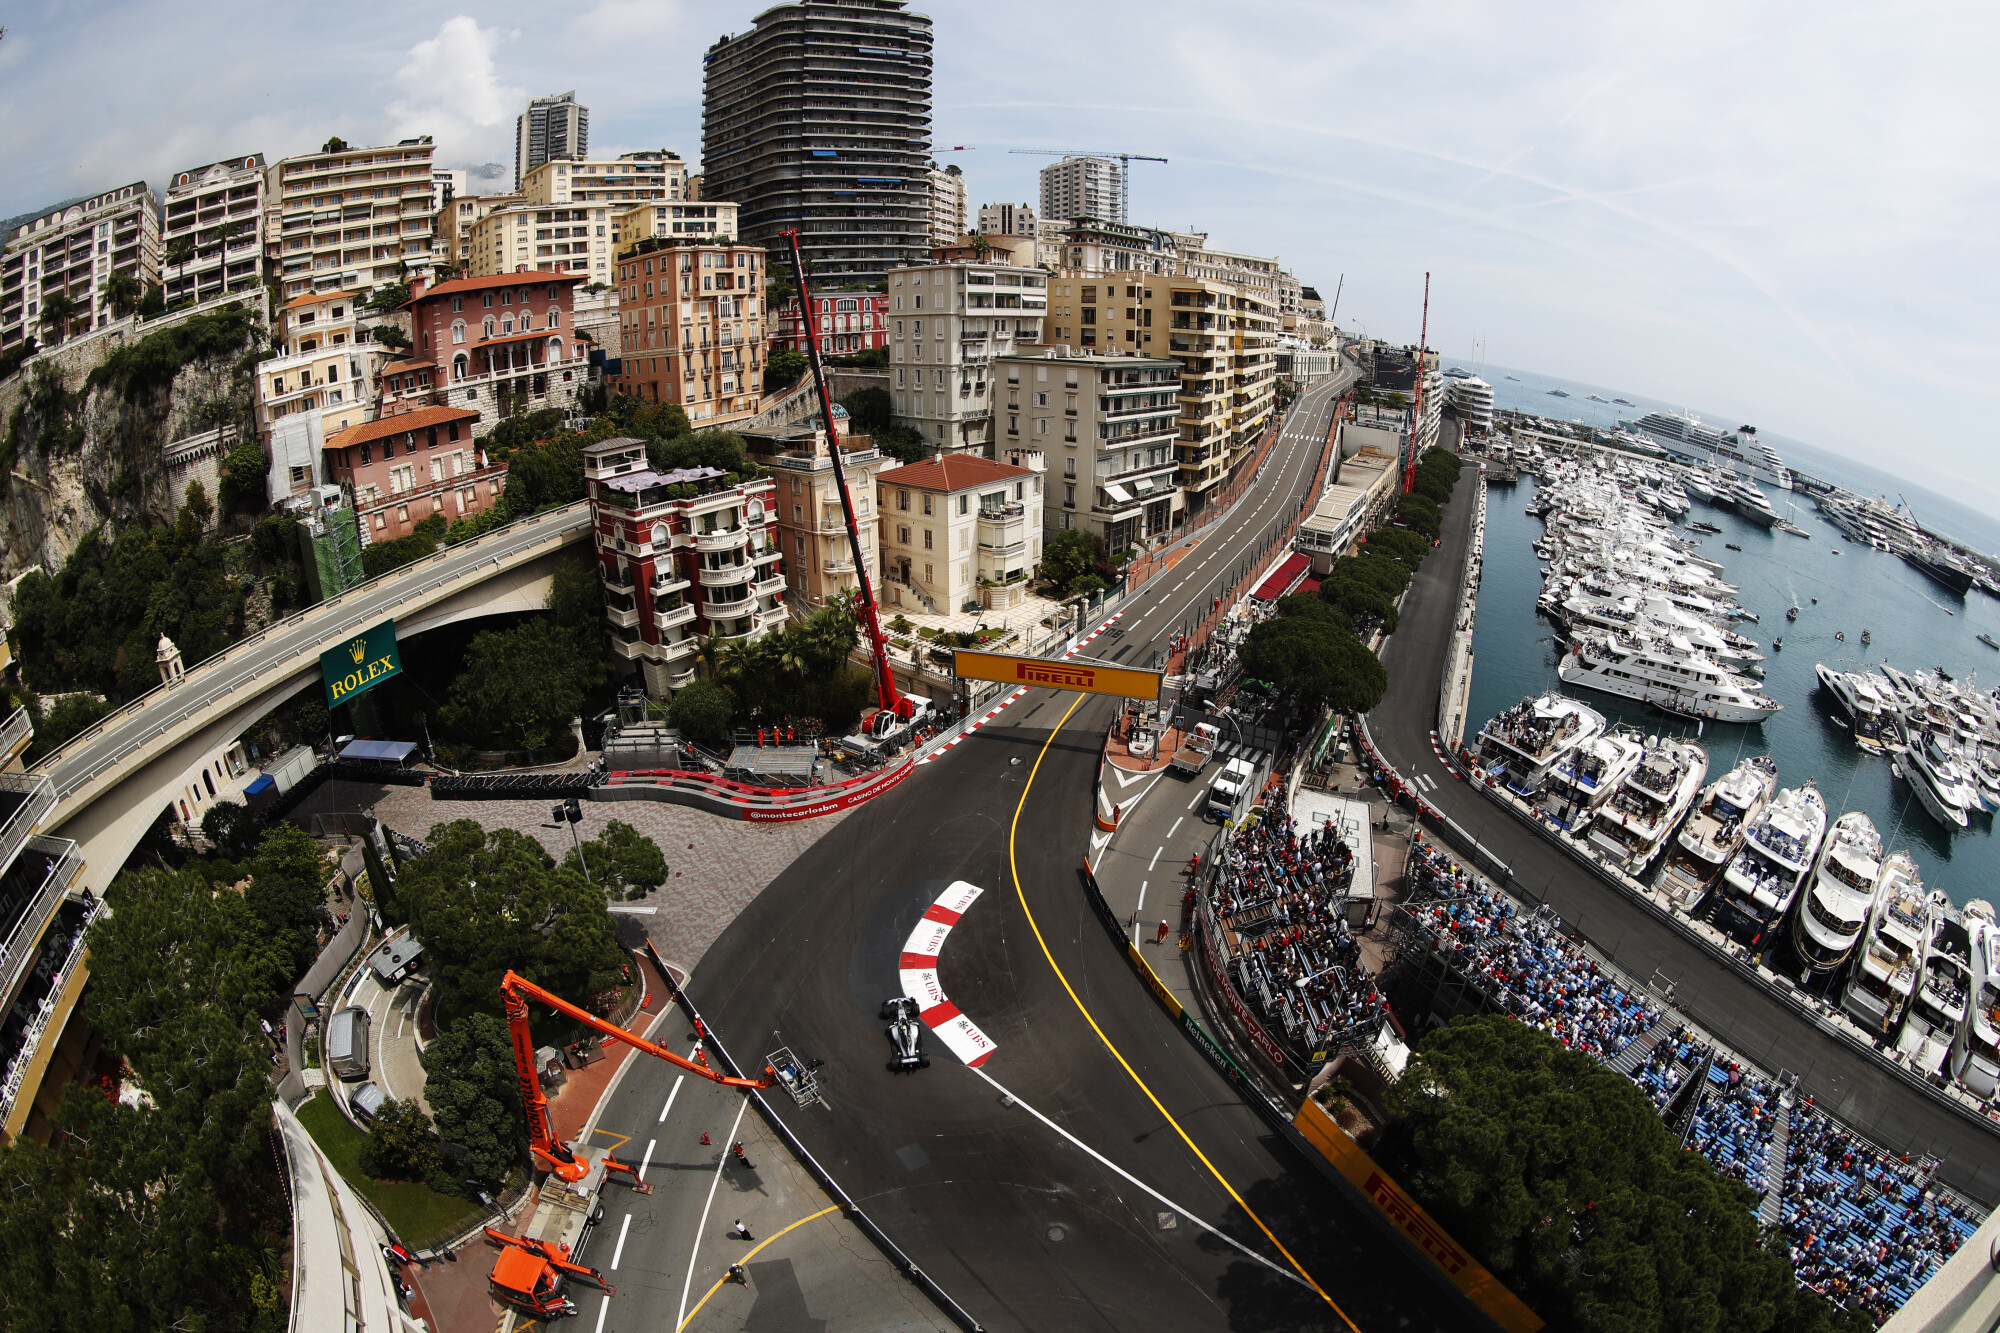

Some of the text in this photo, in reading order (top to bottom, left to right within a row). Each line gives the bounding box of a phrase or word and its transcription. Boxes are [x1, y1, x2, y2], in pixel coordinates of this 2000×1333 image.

[331, 654, 395, 700] ROLEX
[1016, 662, 1095, 688] PIRELLI
[847, 790, 872, 803] CASINO
[872, 785, 882, 794] DE
[750, 802, 839, 819] @montecarlosbm
[954, 895, 972, 911] UBS
[926, 935, 944, 953] UBS
[925, 981, 941, 1001] UBS
[1221, 977, 1284, 1064] MONTE-CARLO
[966, 1028, 989, 1049] UBS
[1185, 1018, 1227, 1069] Heineken
[520, 1076, 543, 1139] LOCNACELLE
[1363, 1171, 1468, 1275] PIRELLI
